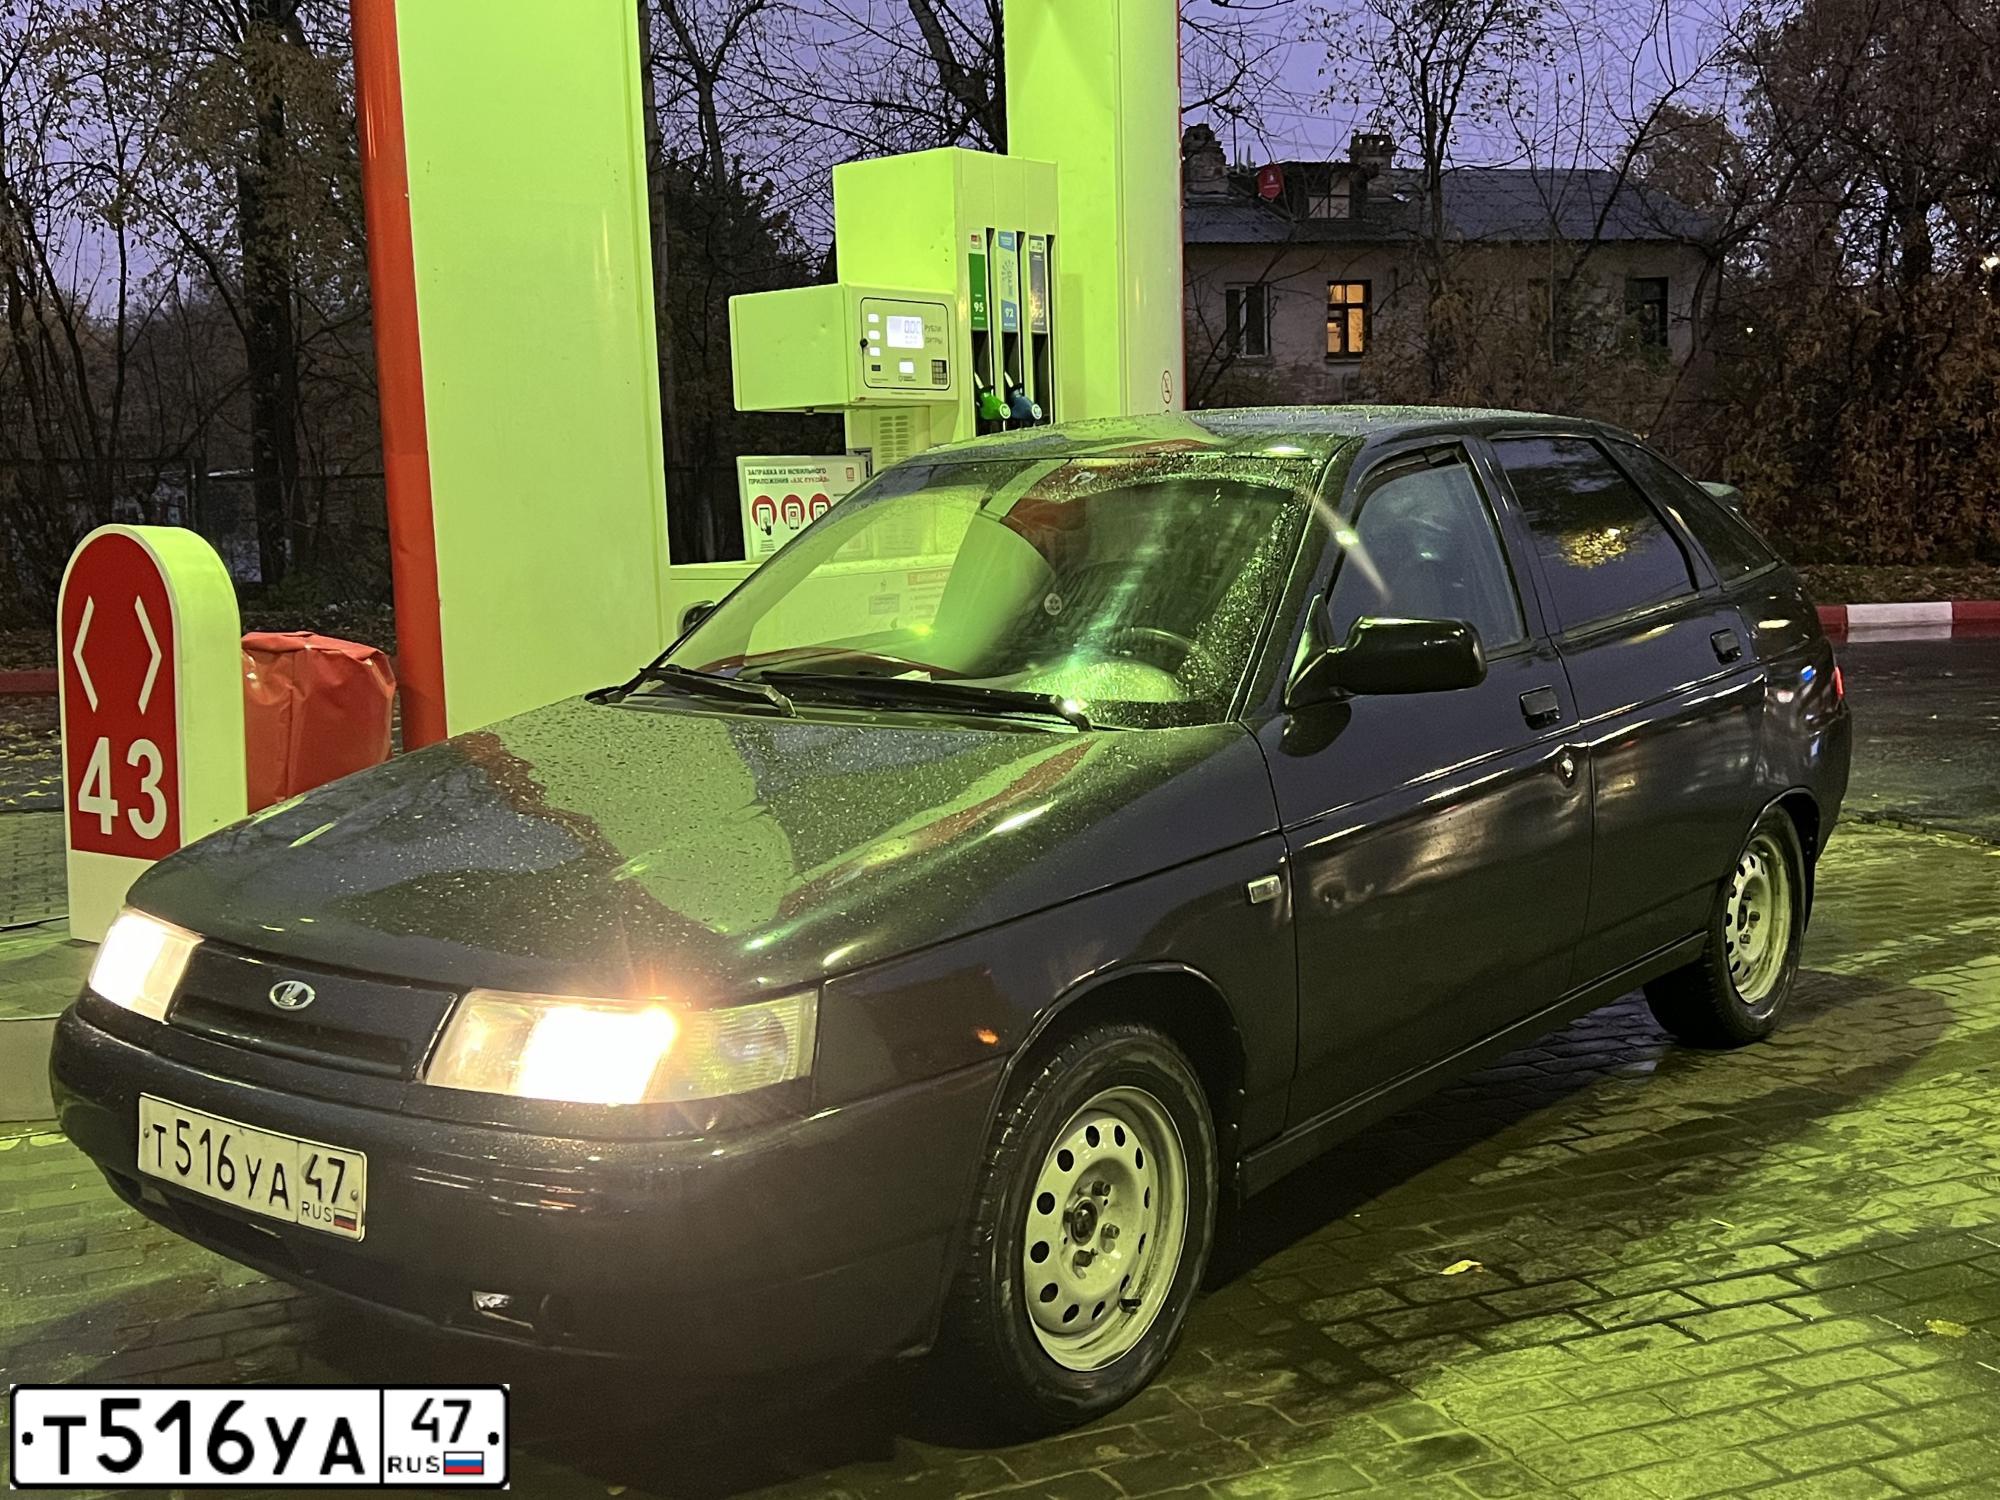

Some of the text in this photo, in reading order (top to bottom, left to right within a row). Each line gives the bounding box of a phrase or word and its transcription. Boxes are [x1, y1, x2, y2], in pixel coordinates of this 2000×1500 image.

[973, 302, 984, 313] 95
[1004, 307, 1014, 318] 92
[152, 1118, 346, 1211] Т516УА 47
[301, 1201, 332, 1223] RUS
